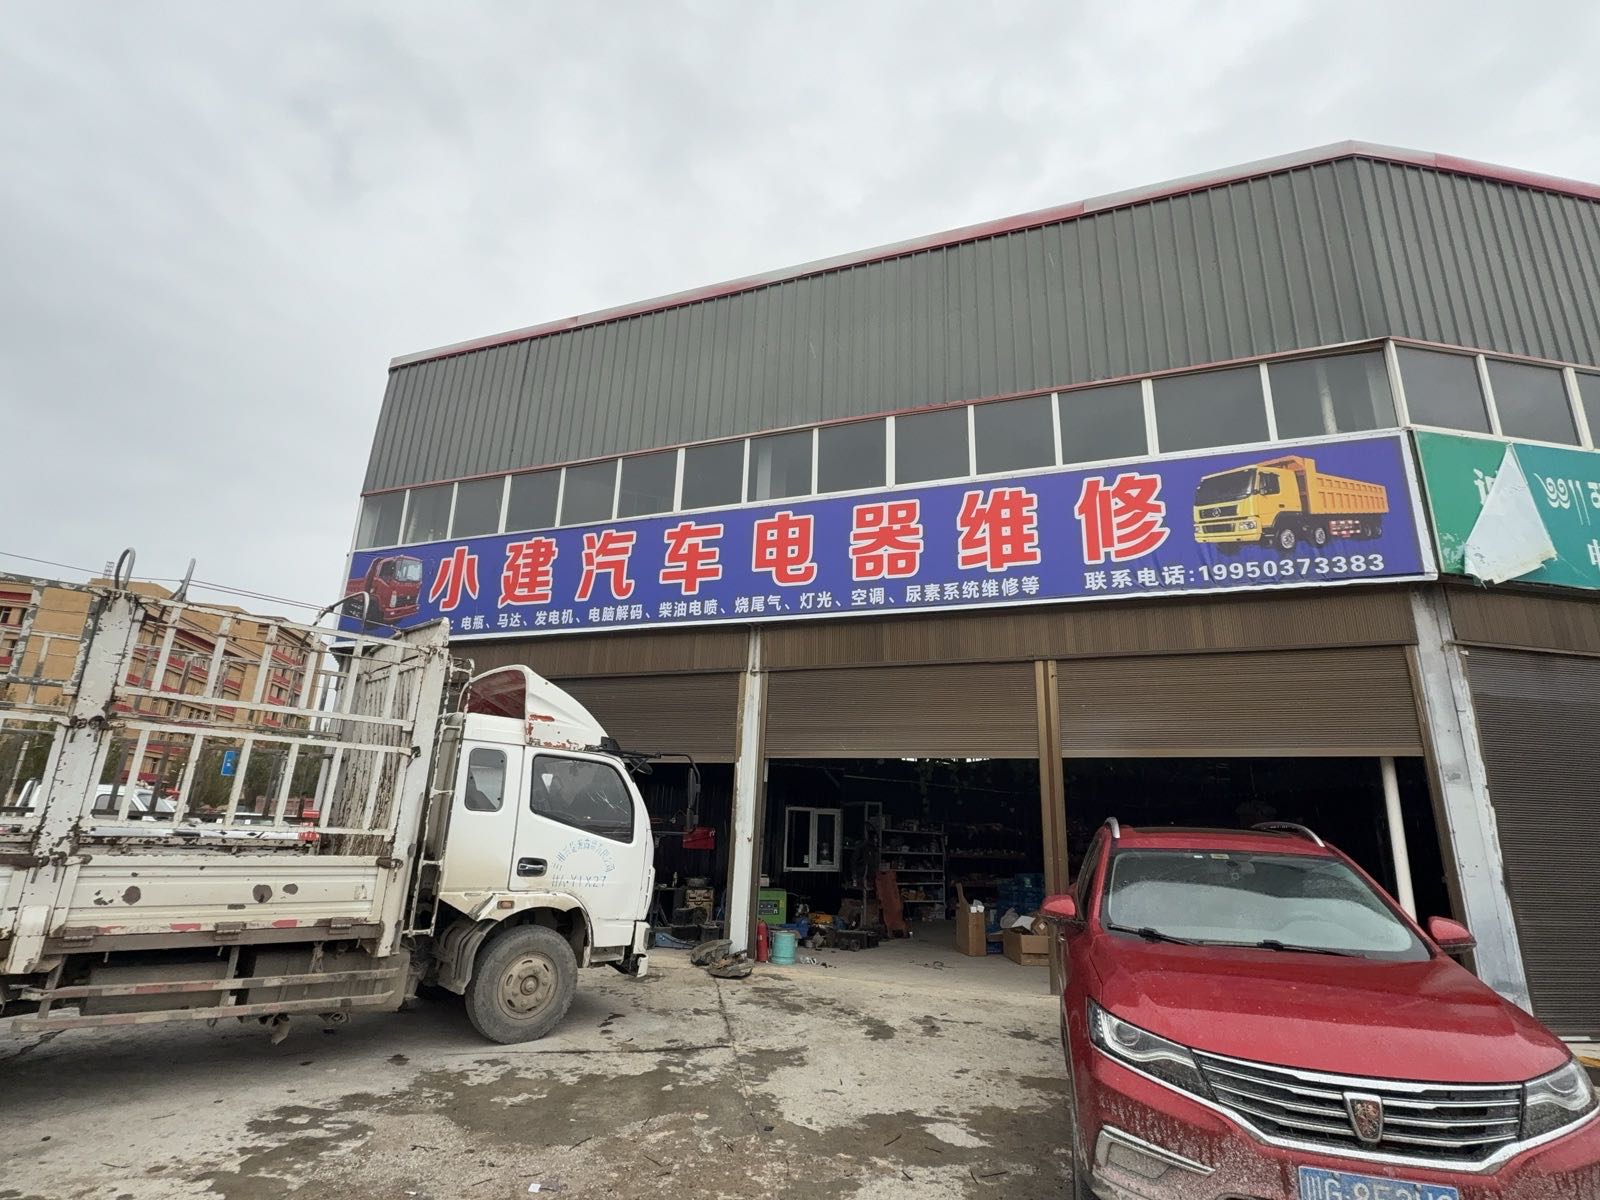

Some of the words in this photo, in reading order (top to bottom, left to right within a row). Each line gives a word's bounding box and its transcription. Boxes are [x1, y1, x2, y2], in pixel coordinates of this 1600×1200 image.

[429, 471, 1170, 611] 小建汽车电器维修
